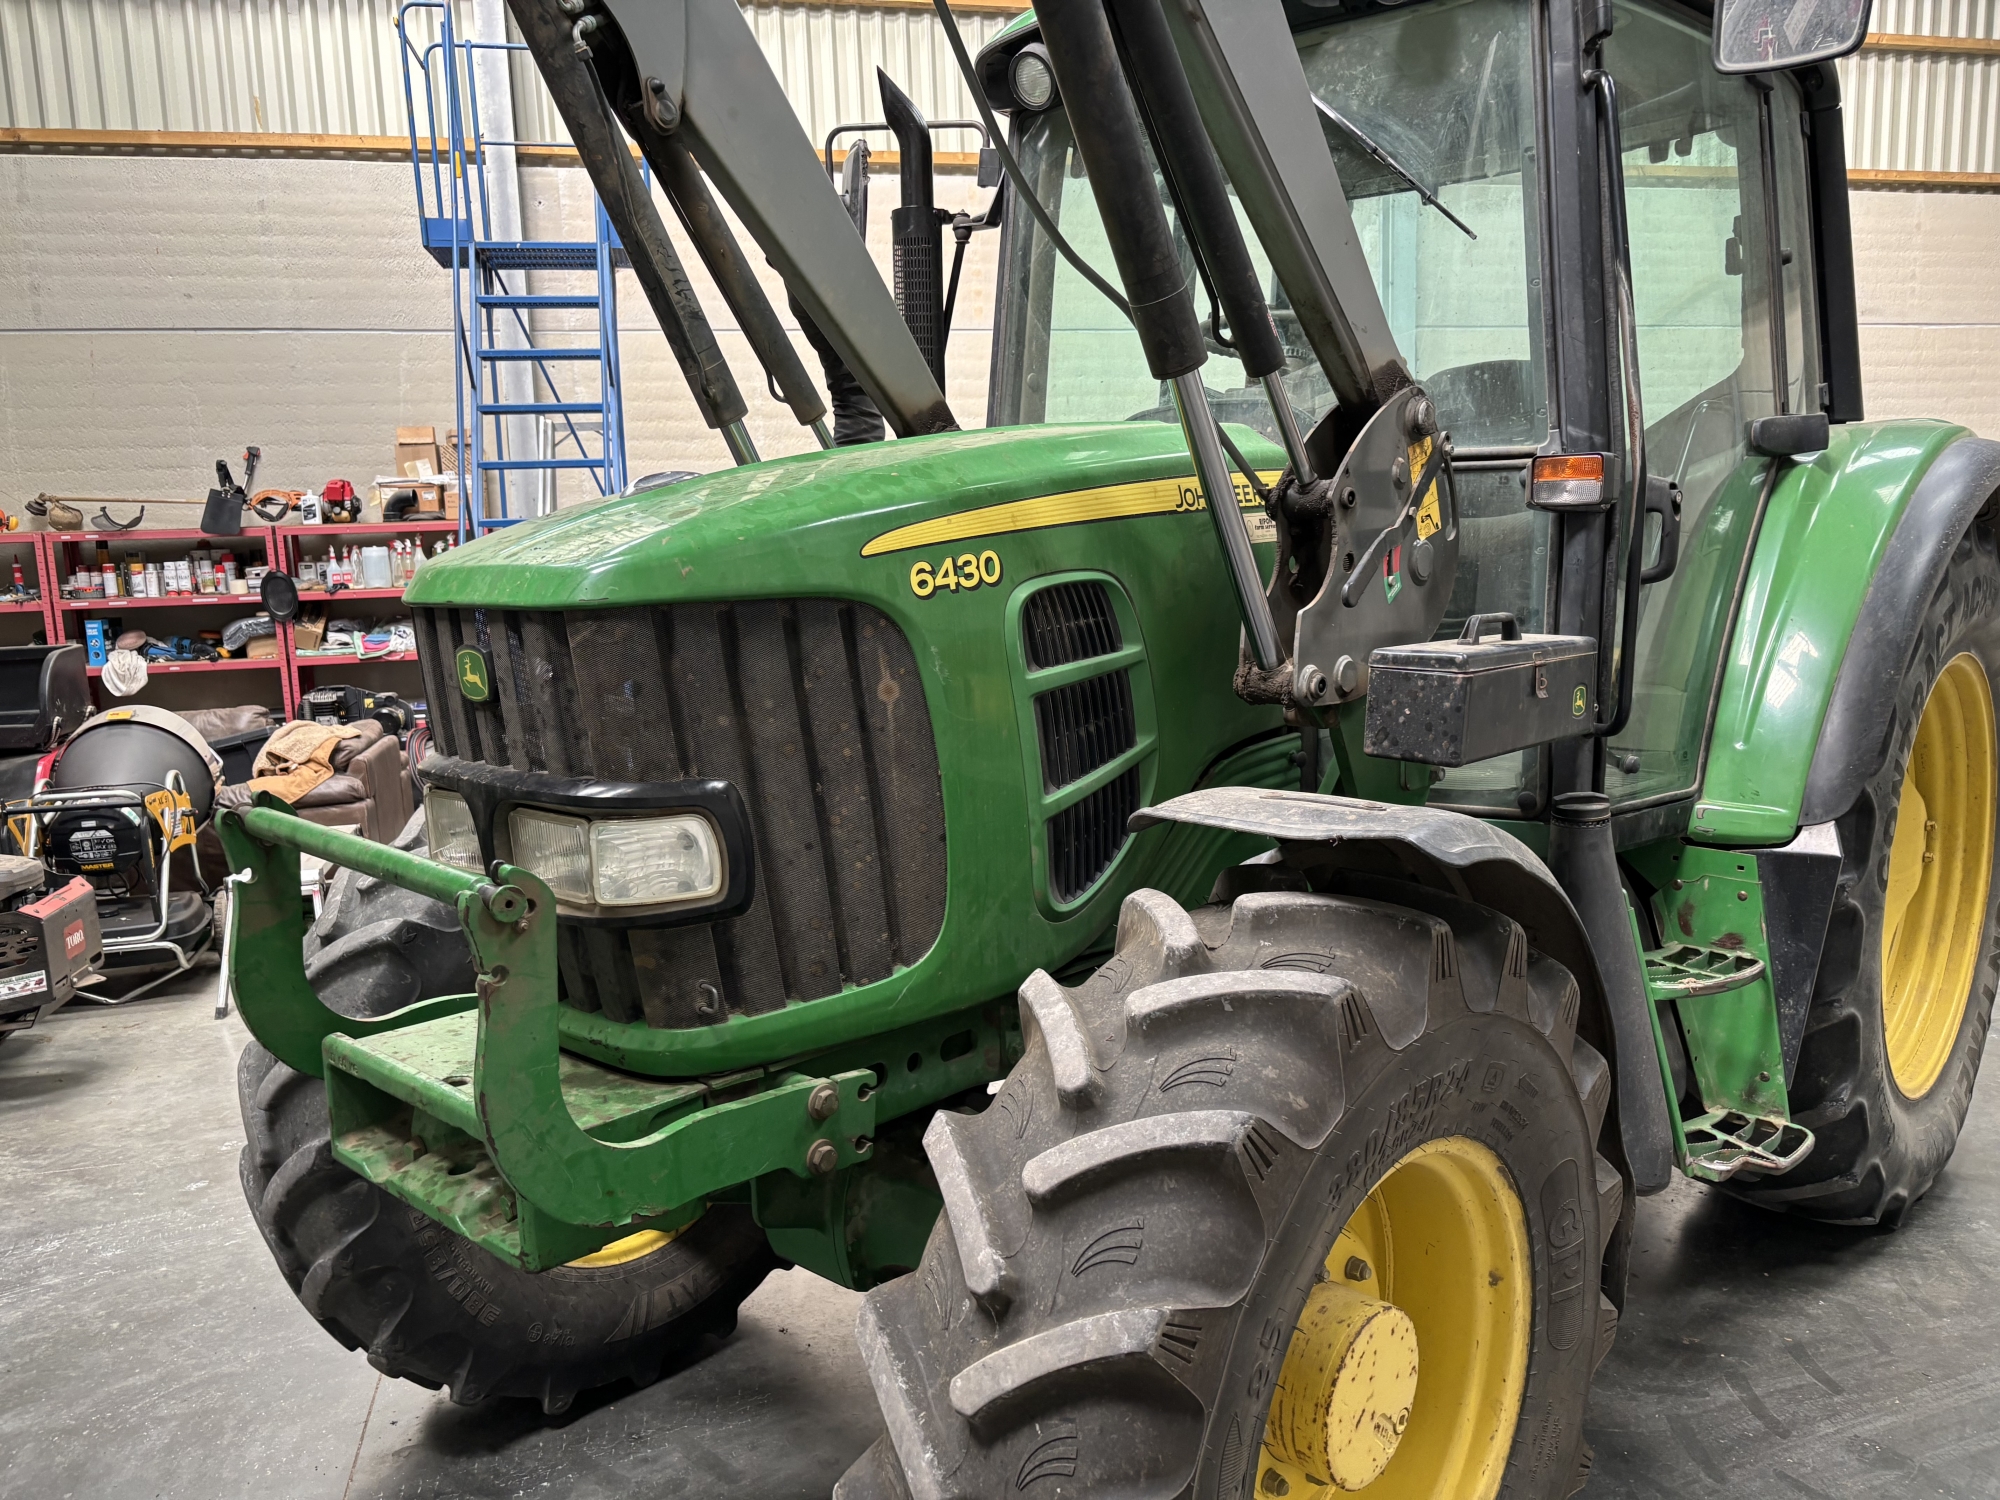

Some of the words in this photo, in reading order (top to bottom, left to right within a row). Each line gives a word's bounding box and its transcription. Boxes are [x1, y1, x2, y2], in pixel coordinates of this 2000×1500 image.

[1176, 484, 1205, 508] JOH
[909, 549, 1003, 600] 6430
[81, 862, 114, 871] MASTER
[66, 930, 84, 950] TORO
[405, 1208, 501, 1327] 380/85R
[1547, 1196, 1586, 1306] GRI
